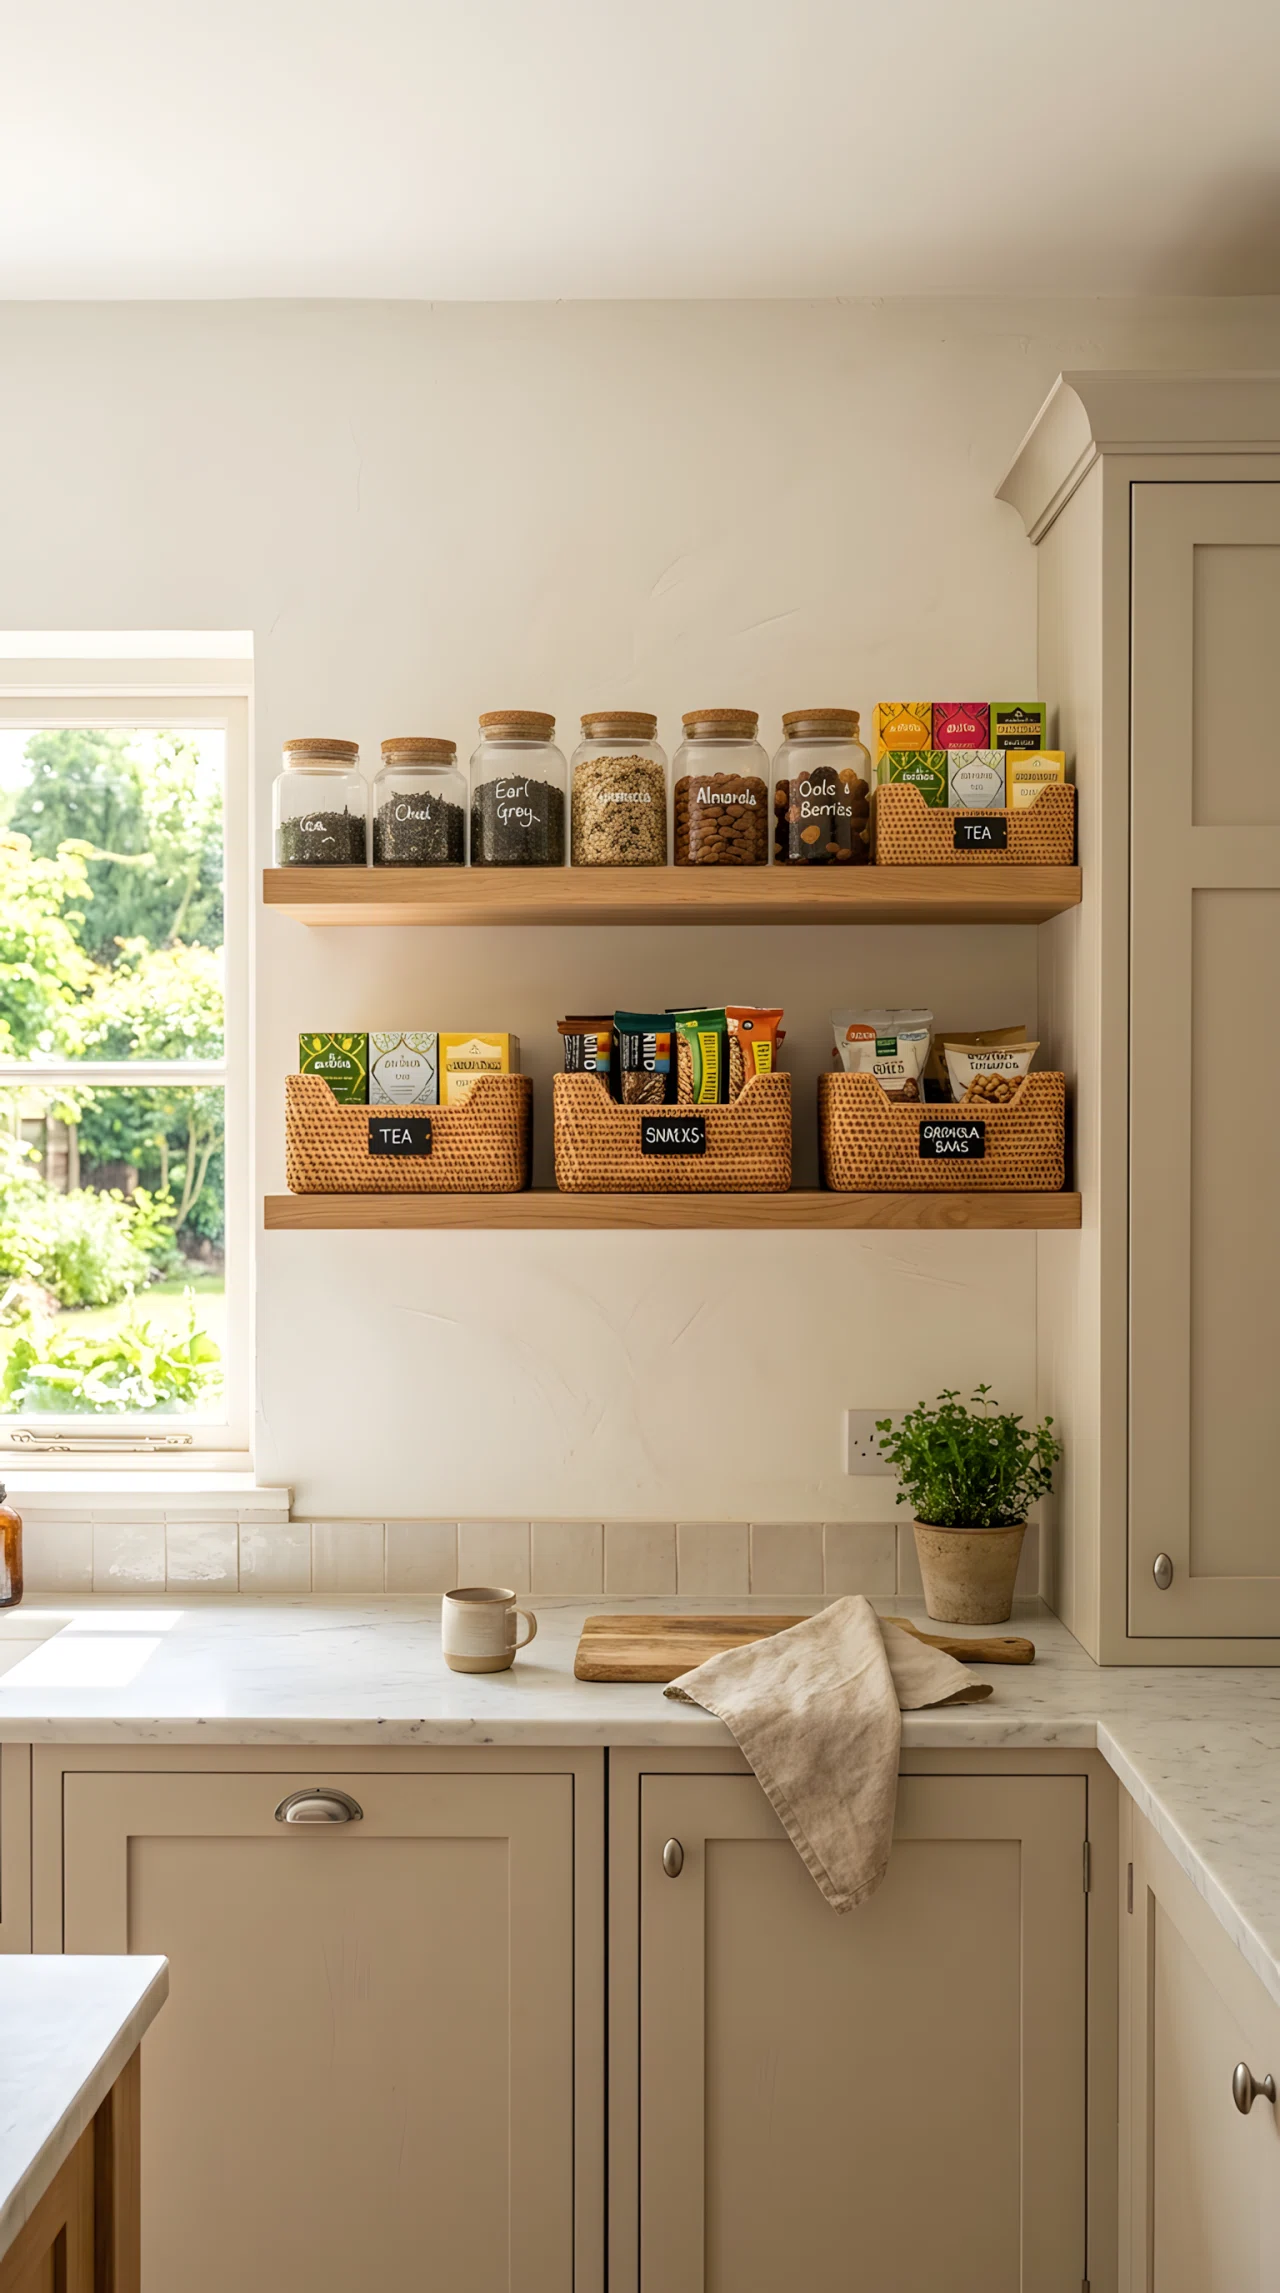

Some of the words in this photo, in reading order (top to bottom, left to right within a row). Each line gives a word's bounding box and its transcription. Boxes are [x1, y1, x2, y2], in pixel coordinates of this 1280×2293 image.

[495, 780, 530, 799] Earl
[801, 801, 853, 819] Berries
[963, 825, 992, 840] TEA
[379, 1128, 413, 1145] TEA
